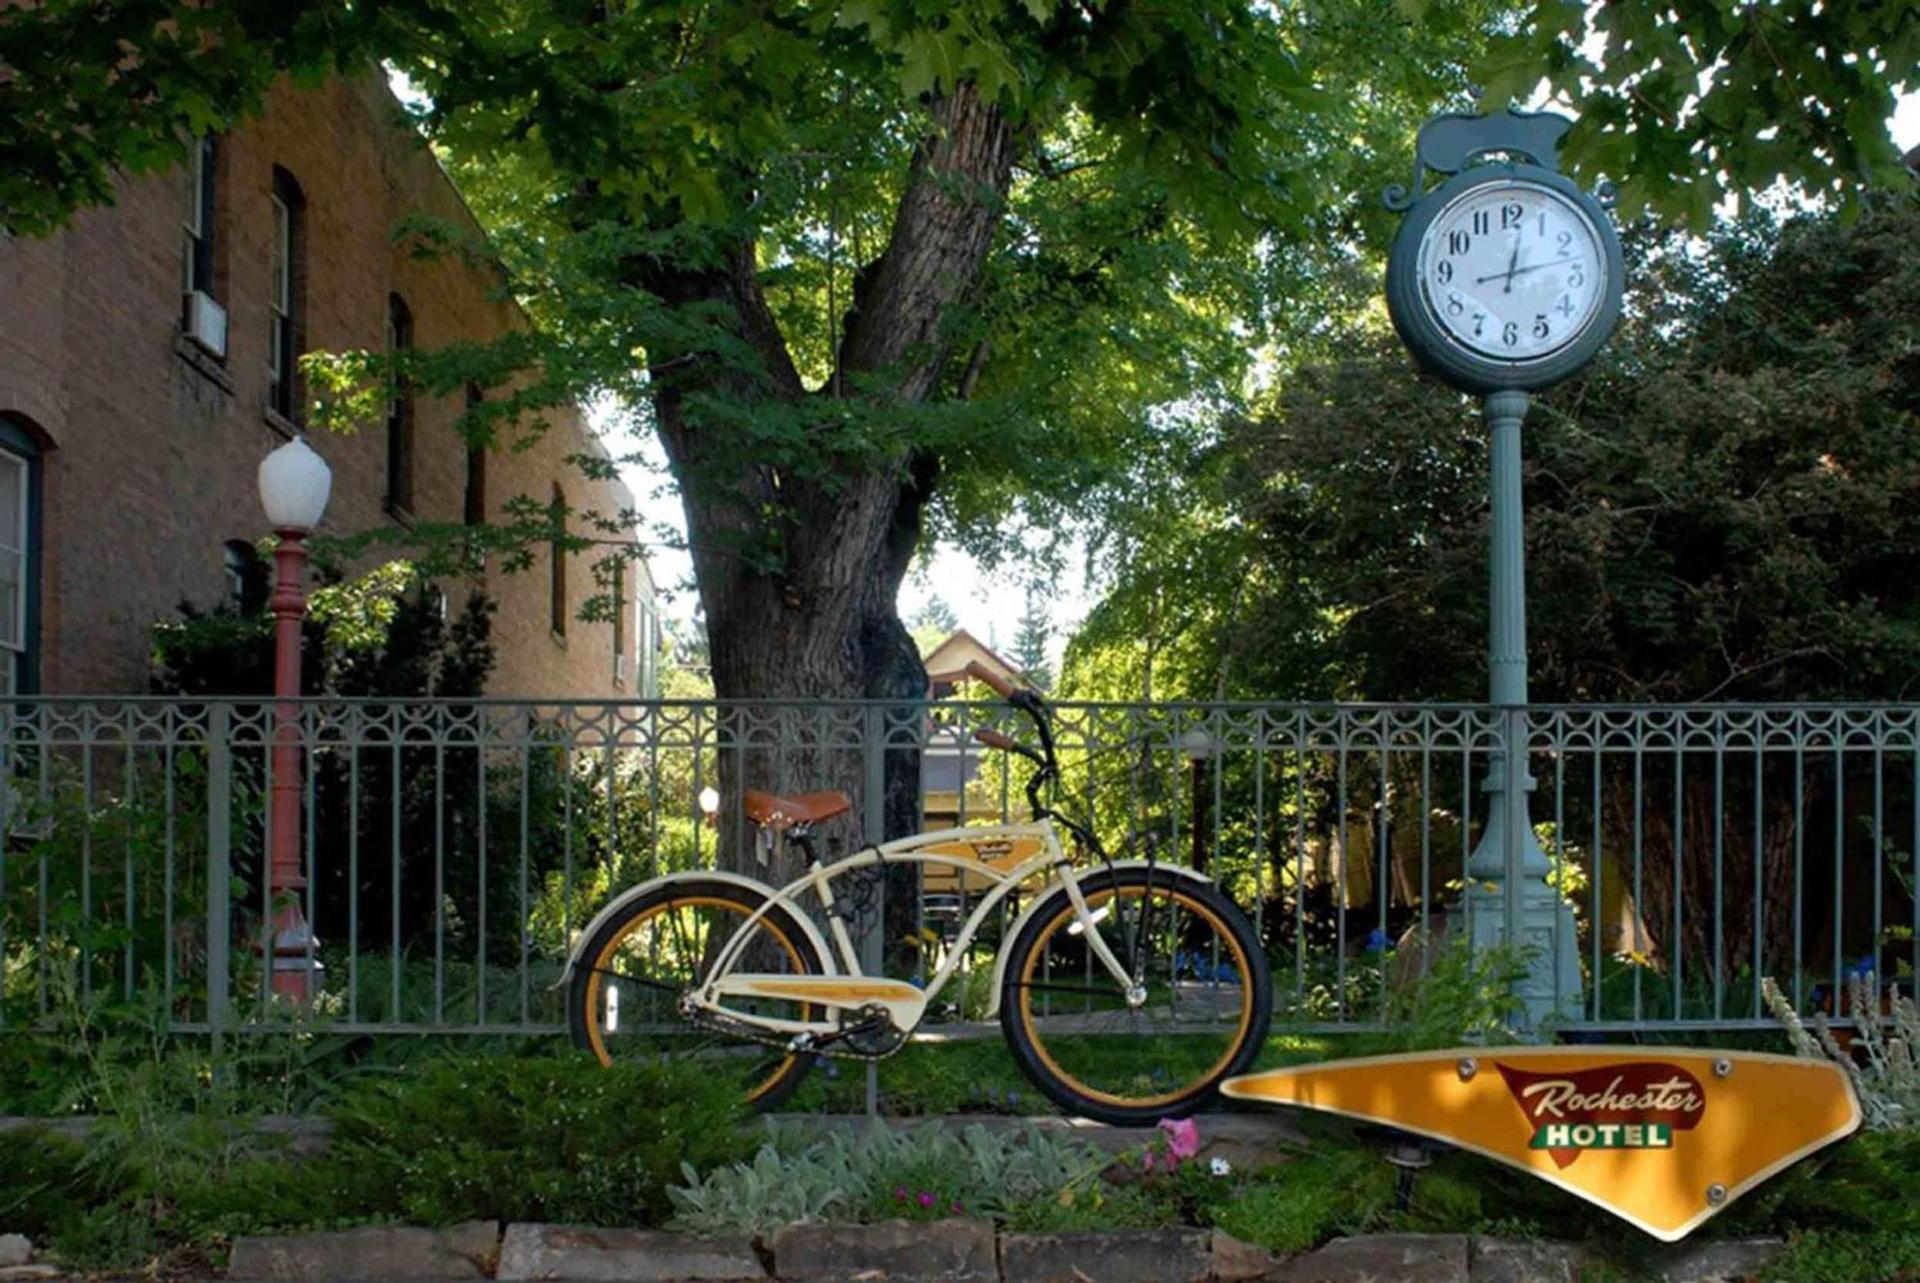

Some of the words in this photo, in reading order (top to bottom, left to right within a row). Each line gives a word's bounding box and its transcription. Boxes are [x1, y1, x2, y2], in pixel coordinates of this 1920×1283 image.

[1474, 211, 1489, 235] 11
[1502, 204, 1523, 230] 12
[1539, 213, 1545, 237] 1
[1449, 231, 1470, 256] 10
[1557, 232, 1572, 256] 2
[1438, 261, 1453, 284] 9
[1567, 264, 1584, 287] 3
[1449, 294, 1464, 317] 8
[1556, 294, 1574, 318] 4
[1472, 313, 1487, 337] 7
[1503, 322, 1518, 346] 6
[1533, 314, 1550, 338] 5
[1523, 1076, 1703, 1118] Rochester
[1547, 1124, 1667, 1146] HOTEL
